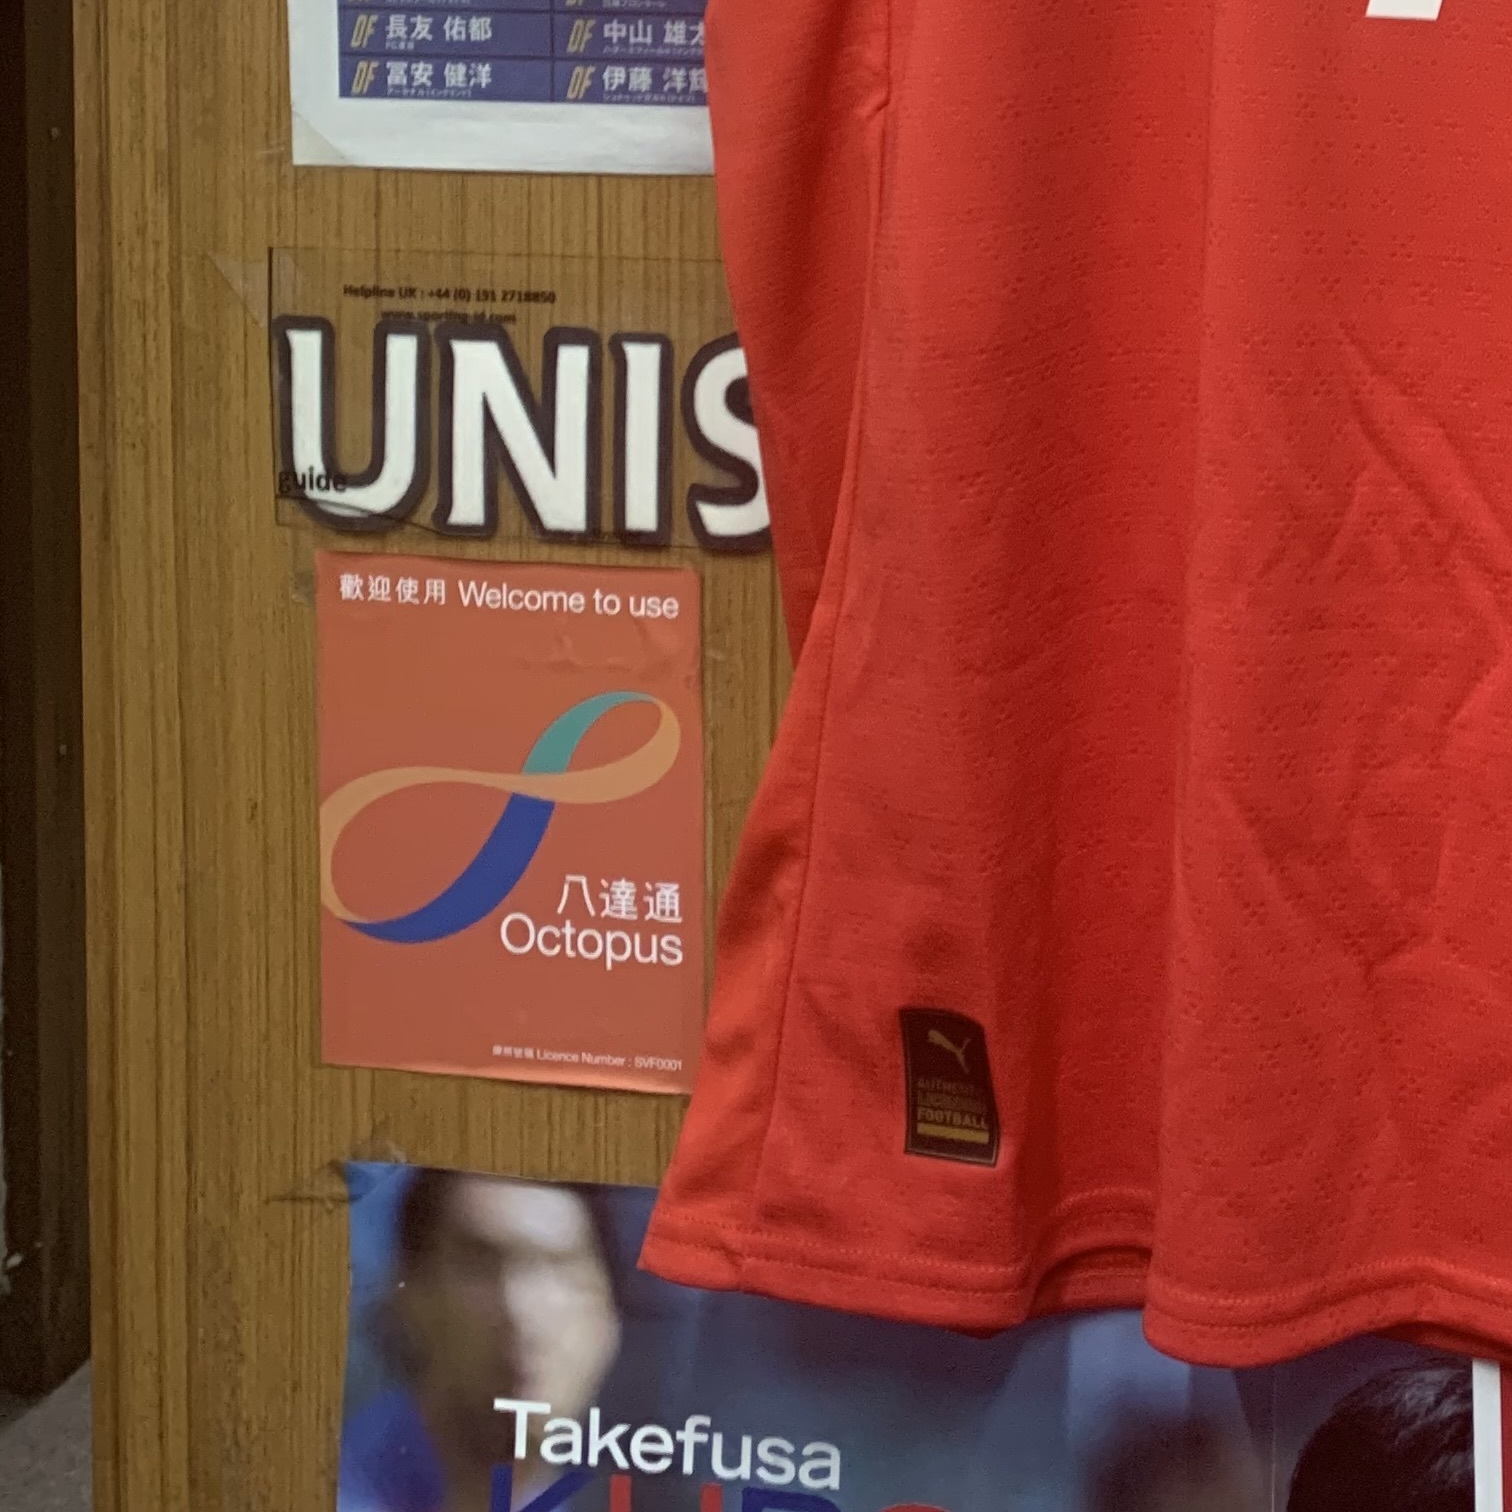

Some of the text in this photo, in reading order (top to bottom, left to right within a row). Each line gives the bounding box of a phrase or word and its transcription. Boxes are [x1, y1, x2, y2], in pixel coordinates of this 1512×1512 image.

[350, 14, 492, 48] DF 長友 佑都
[566, 19, 597, 52] DF
[603, 19, 652, 44] 中山
[351, 61, 379, 94] DF
[444, 62, 492, 88] 健洋
[566, 66, 597, 99] DF
[603, 66, 652, 92] 伊藤
[343, 284, 395, 300] Helpline
[453, 288, 471, 303] (0)
[278, 468, 346, 494] guide
[339, 574, 679, 619] 歡迎使用 Welcome to use
[557, 875, 683, 924] 八達通
[500, 912, 683, 970] Octopus
[582, 1052, 625, 1067] Number
[493, 1398, 841, 1490] Takefusa
